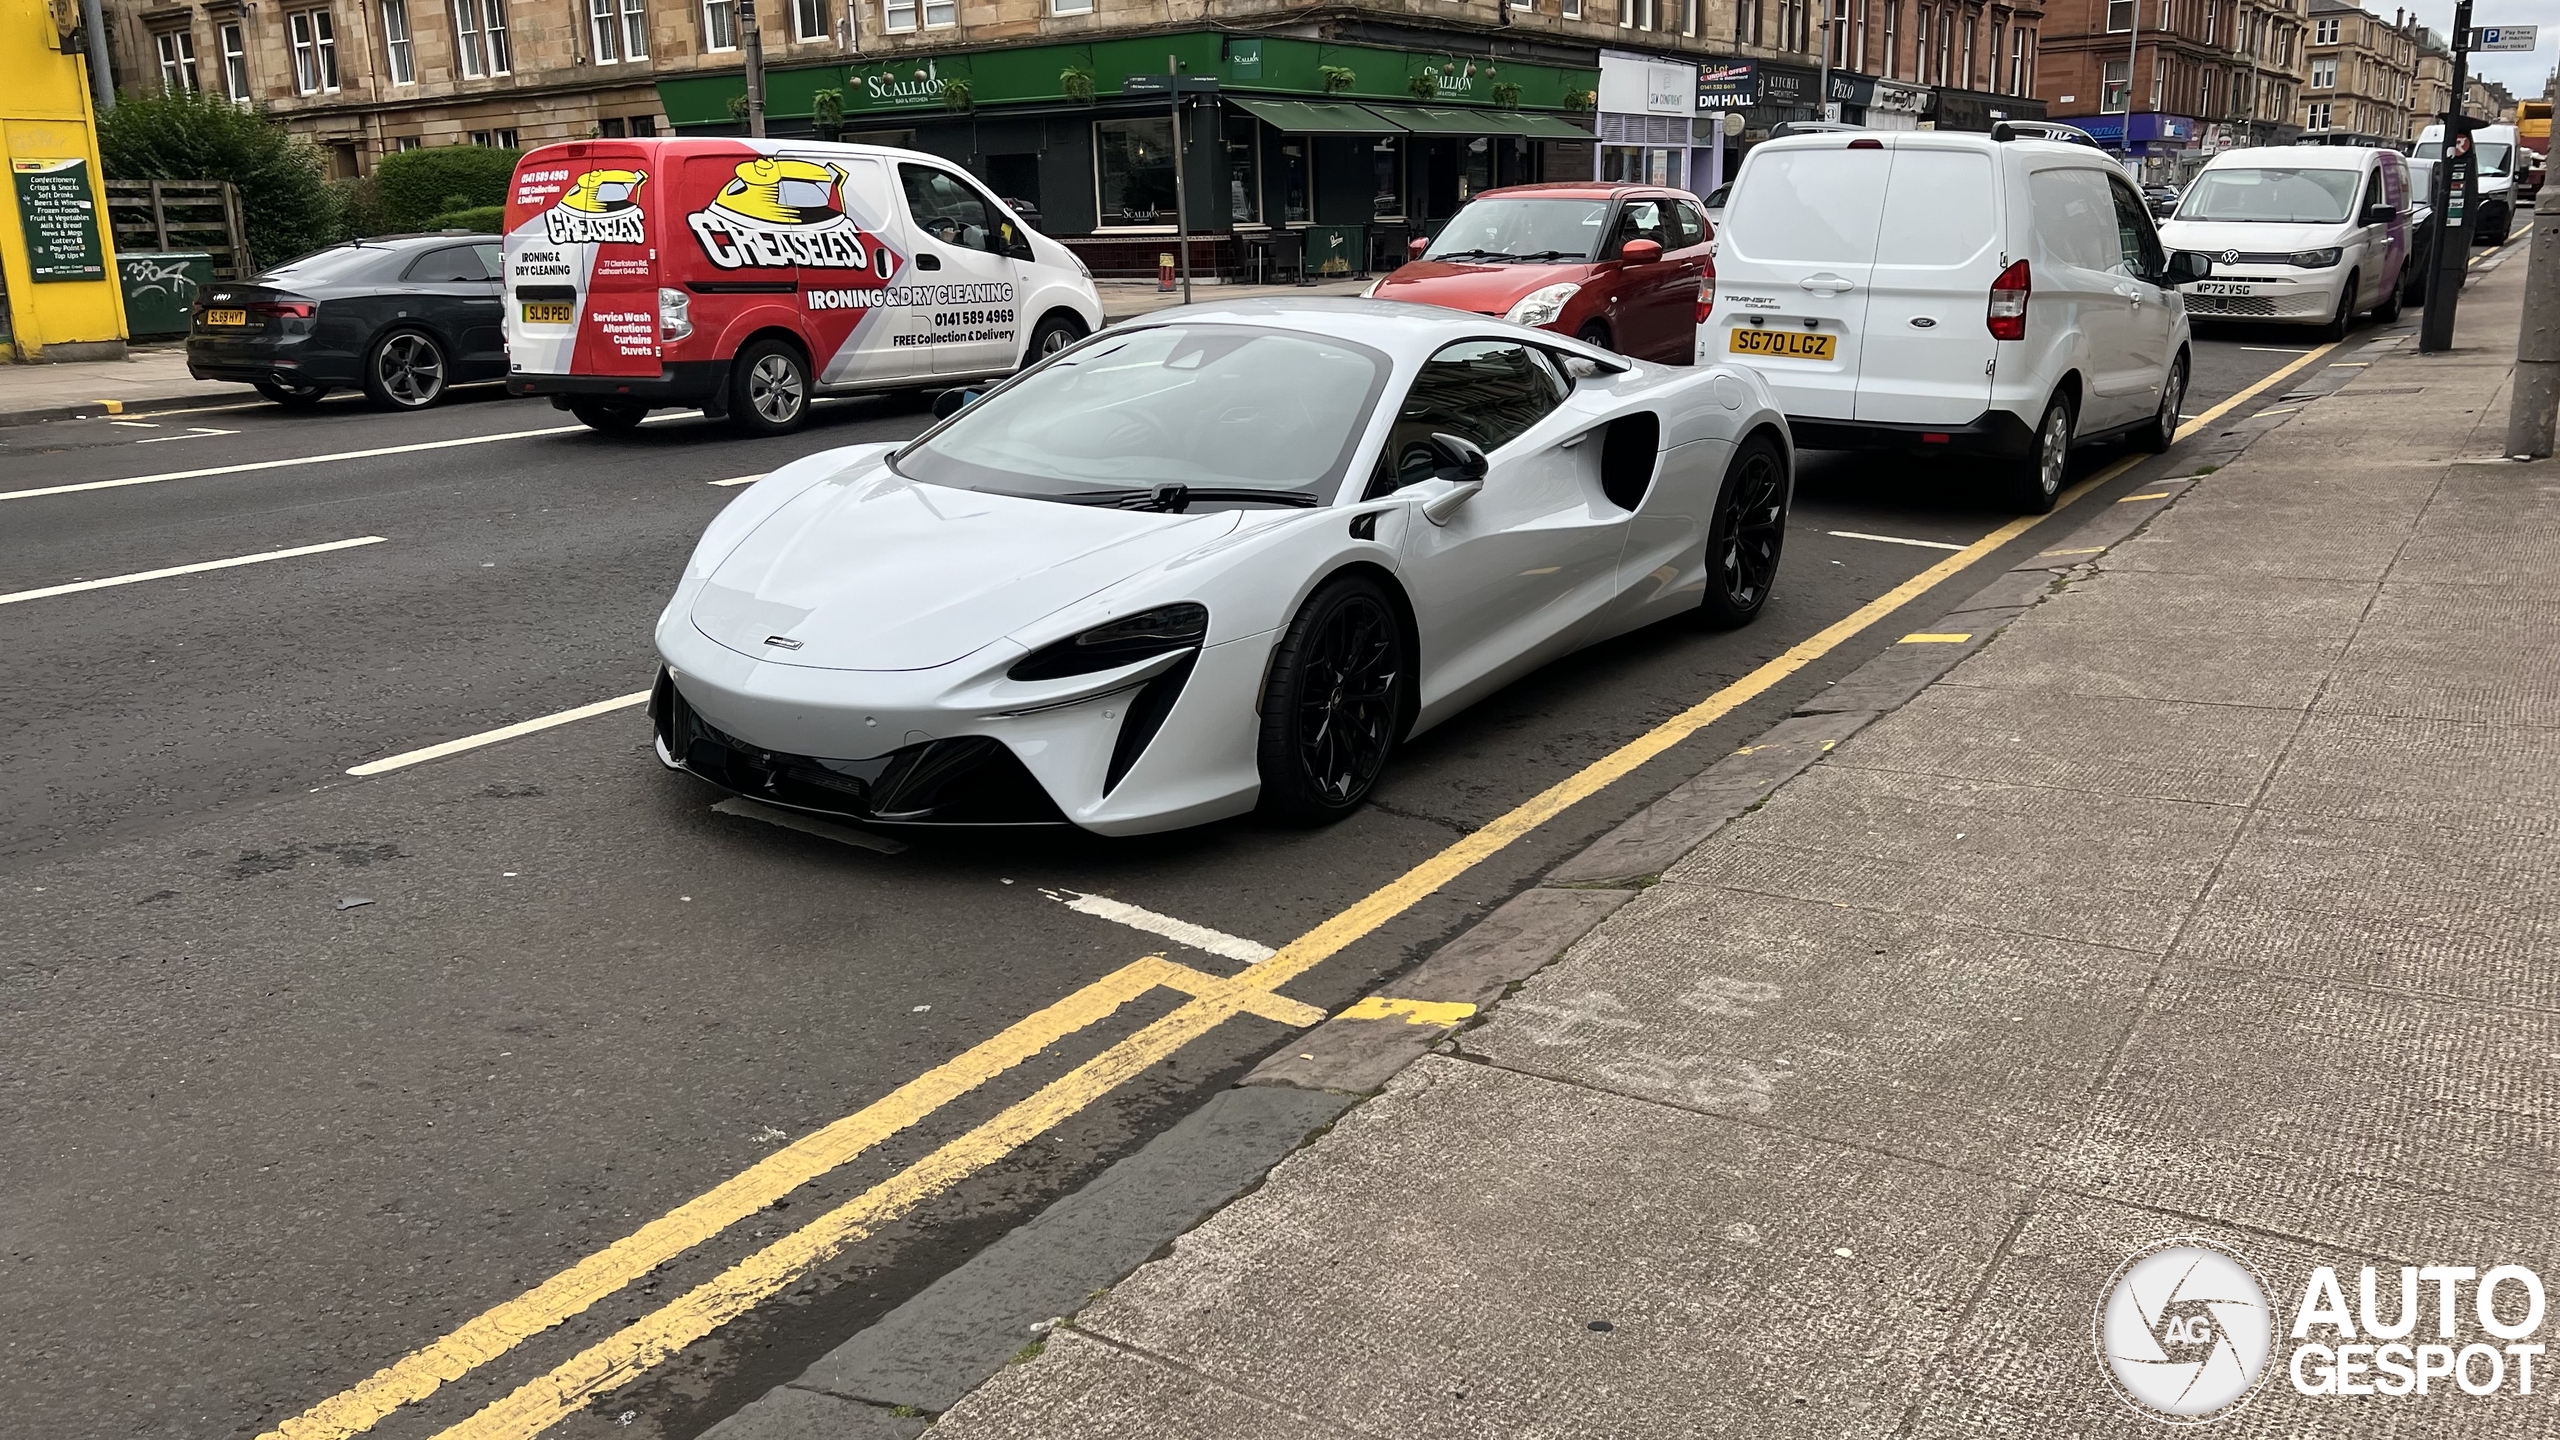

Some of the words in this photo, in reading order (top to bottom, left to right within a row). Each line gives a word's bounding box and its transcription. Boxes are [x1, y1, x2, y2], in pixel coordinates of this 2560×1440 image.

[1701, 64, 1712, 74] To
[1707, 72, 1728, 80] UNDER
[1728, 66, 1747, 75] OFFER
[868, 76, 948, 98] SCALLION
[1770, 76, 1799, 90] KITCHEN
[1832, 79, 1854, 99] PELO
[1700, 95, 1719, 107] DM
[1722, 94, 1754, 106] HALL
[30, 176, 76, 184] Confectionery
[522, 172, 535, 184] 0141
[536, 171, 549, 182] 589
[550, 170, 569, 181] 4969
[519, 187, 531, 195] FREE
[531, 184, 560, 194] Collection
[522, 195, 545, 205] Delivery
[1123, 208, 1160, 219] SCALLION
[545, 208, 645, 244] CREASELESS
[687, 212, 868, 270] CREASELESS
[522, 252, 553, 262] IRONING
[555, 252, 560, 262] &
[516, 266, 530, 276] DRY
[530, 265, 570, 276] CLEANING
[2197, 284, 2225, 294] WP72
[2229, 285, 2250, 295] VSG
[807, 289, 884, 310] IRONING
[885, 288, 899, 307] &
[899, 286, 935, 306] DRY
[936, 283, 1014, 304] CLEANING
[211, 312, 227, 322] SL69
[530, 306, 549, 320] SL19
[593, 312, 623, 322] Service
[624, 312, 651, 322] Wash
[935, 312, 960, 326] 0141
[963, 311, 984, 325] 589
[986, 309, 1014, 324] 4969
[603, 323, 652, 333] Alterations
[614, 335, 652, 344] Curtains
[894, 334, 916, 347] FREE
[918, 332, 967, 344] Collection
[968, 330, 974, 341] &
[975, 328, 1014, 343] Delivery
[1738, 331, 1785, 351] SG70
[1790, 335, 1827, 355] LGZ
[621, 347, 652, 355] Duvets
